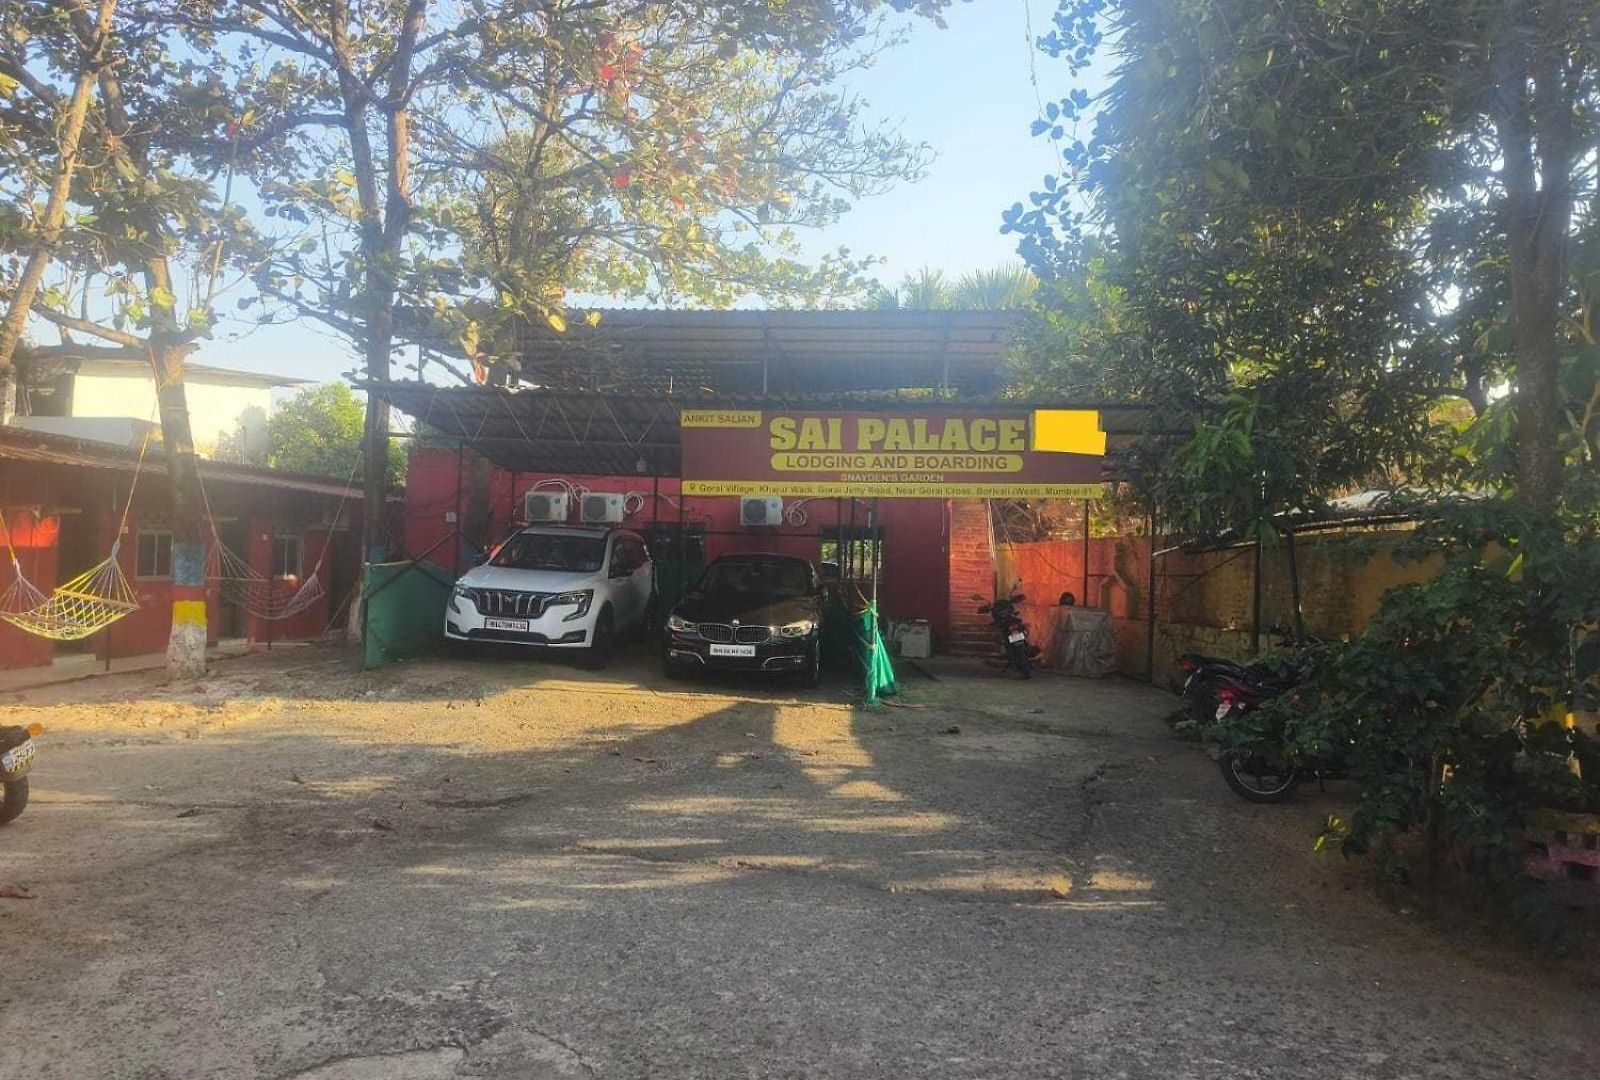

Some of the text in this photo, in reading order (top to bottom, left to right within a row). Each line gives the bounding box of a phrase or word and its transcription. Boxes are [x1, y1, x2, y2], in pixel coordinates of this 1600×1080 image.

[684, 414, 755, 424] ANKIT SALIAN
[769, 416, 1026, 452] SAI PALACE
[786, 456, 1008, 470] LODGING AND BOARDING
[900, 473, 944, 483] GARDEN
[896, 486, 915, 494] Near
